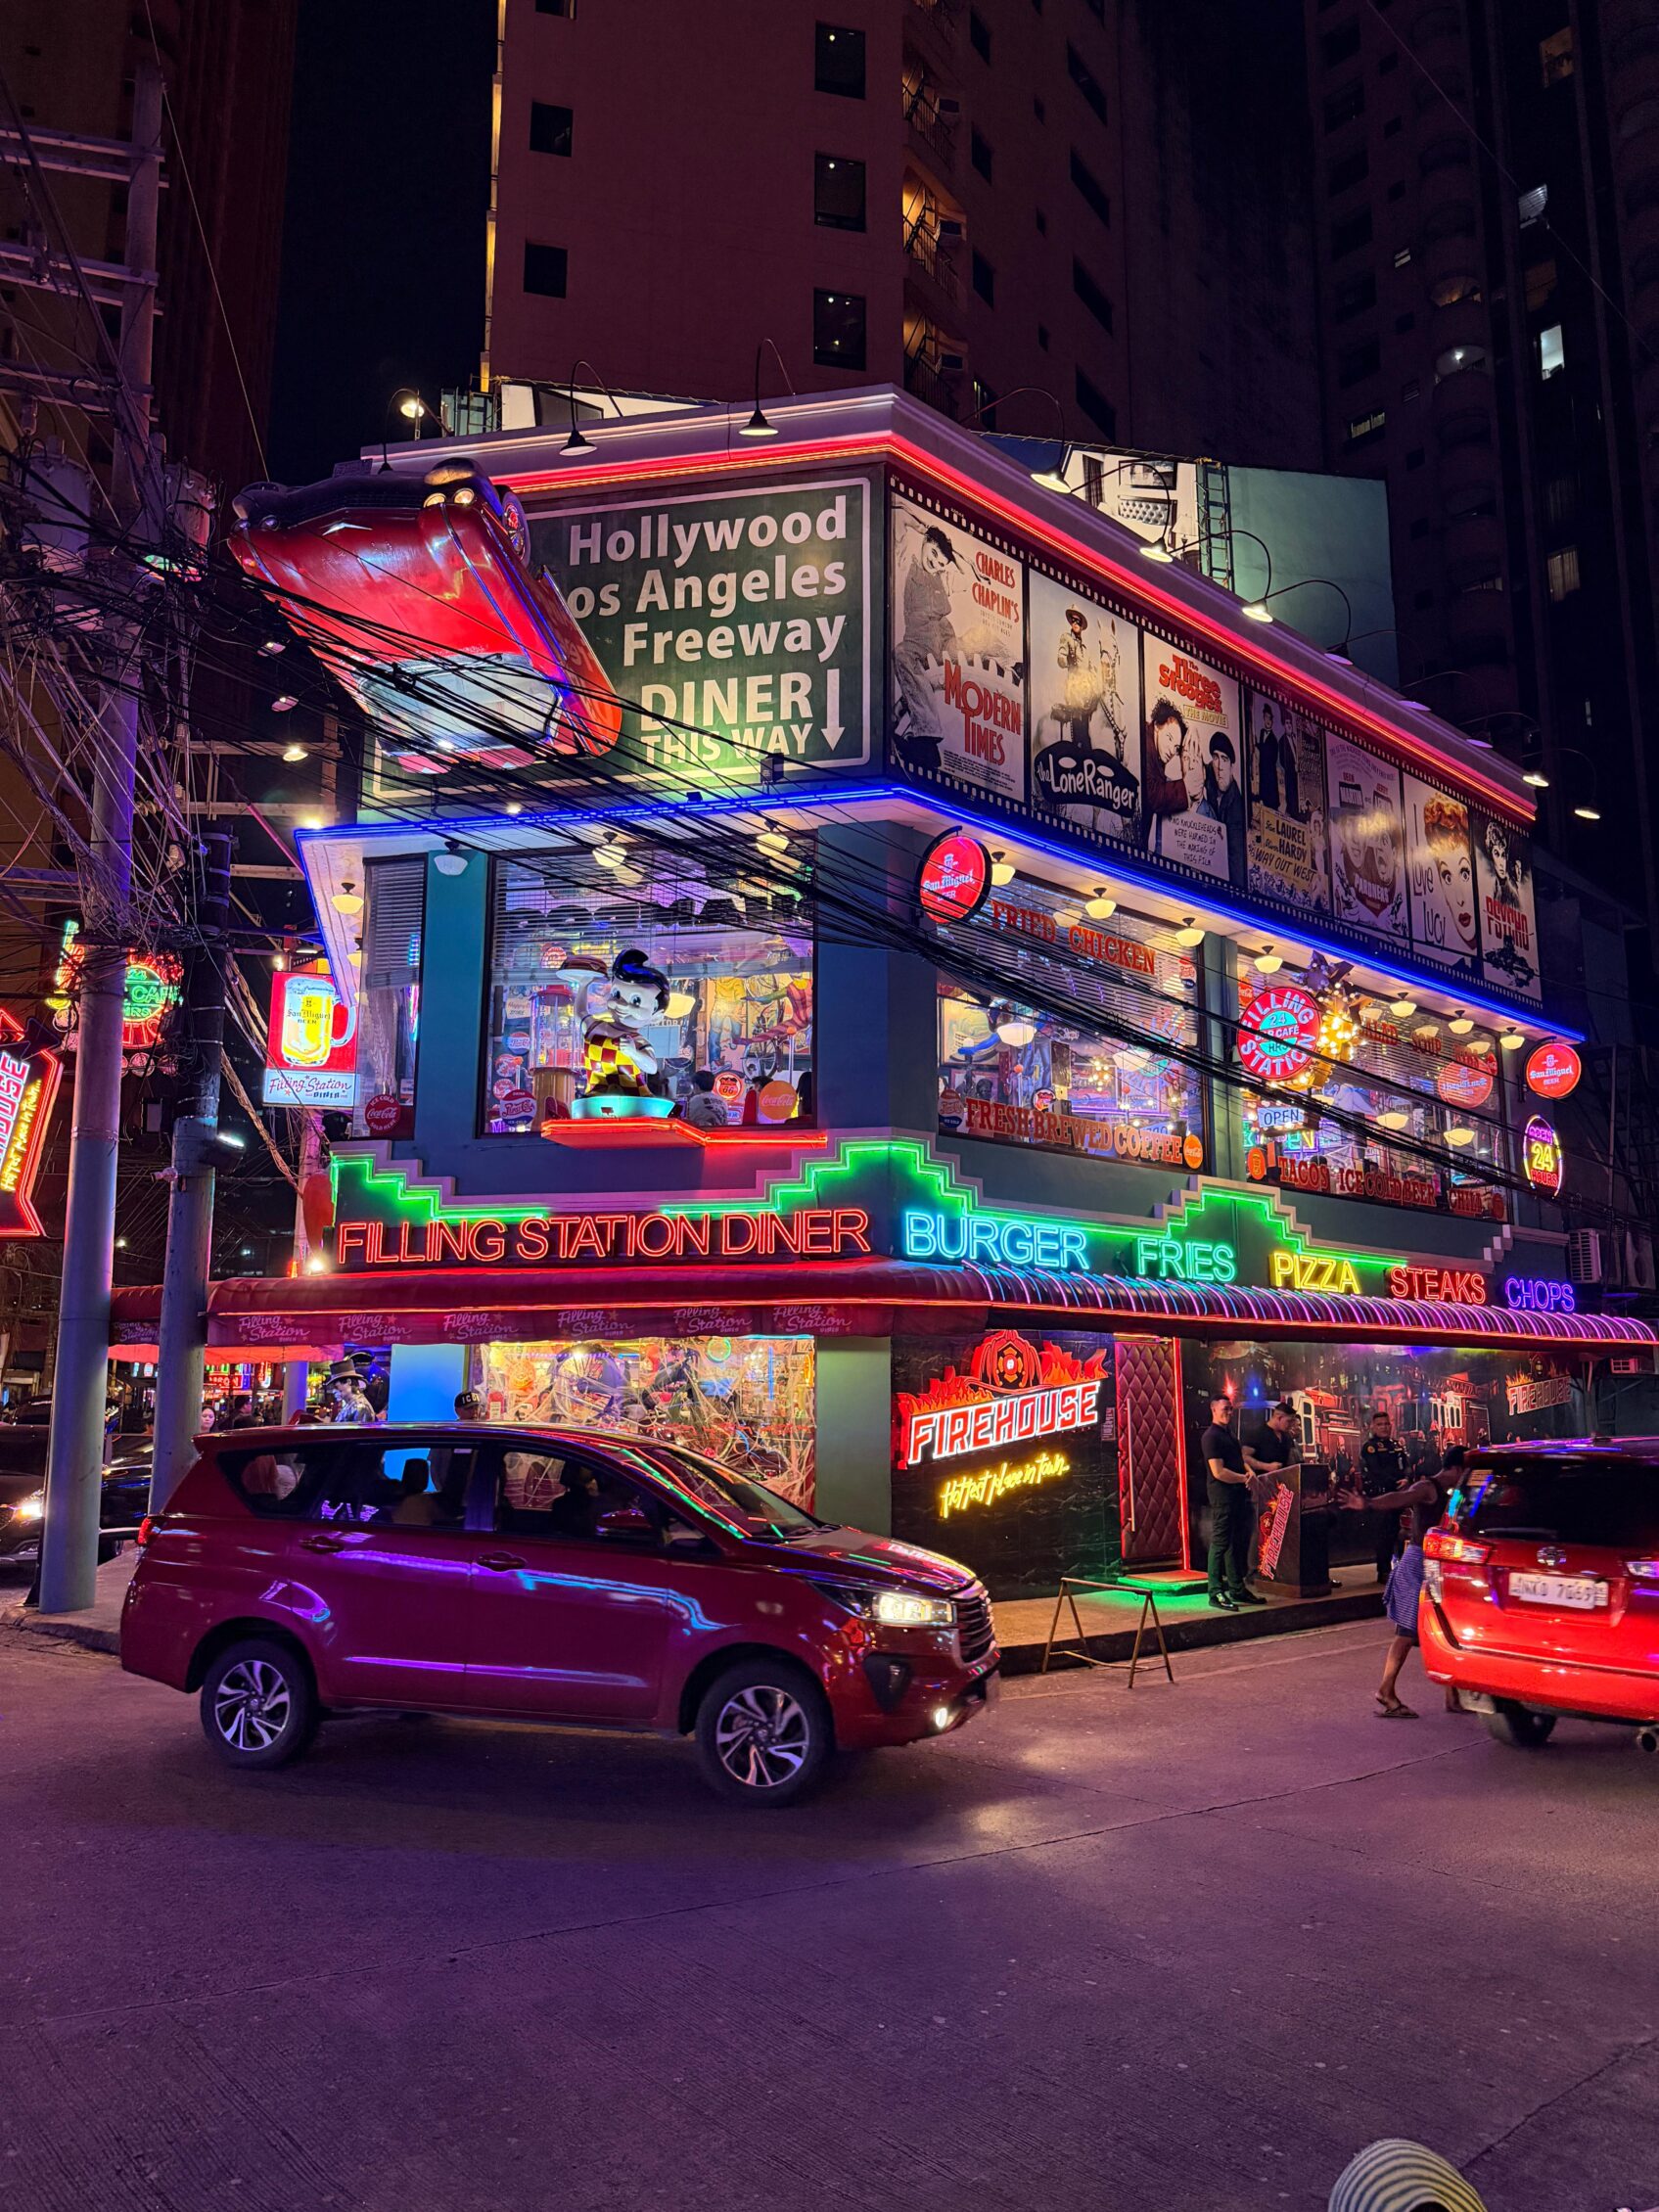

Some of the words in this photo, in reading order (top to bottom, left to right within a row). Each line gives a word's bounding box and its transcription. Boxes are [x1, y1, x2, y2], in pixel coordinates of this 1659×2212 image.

[569, 495, 847, 568] Hollywood
[975, 551, 1016, 589] CHARLES
[567, 583, 621, 619] os
[635, 555, 847, 618] Angeles
[972, 581, 1020, 623] CHAPLIN'S
[623, 615, 847, 667] Freeway
[1158, 664, 1223, 714] Stooges
[1172, 654, 1221, 699] Three
[640, 672, 813, 732] DINER
[945, 659, 1021, 736] MODERN
[1186, 708, 1200, 719] THE
[1202, 712, 1226, 726] MOVIE
[641, 731, 721, 765] THIS
[731, 722, 813, 760] WAY
[961, 707, 1006, 766] TIMES
[1037, 761, 1051, 783] the
[1083, 759, 1135, 810] Ranger
[1181, 819, 1217, 836] KNUCKLEHEADS
[1188, 831, 1209, 844] HARMED
[1275, 819, 1307, 846] LAUREL
[1176, 840, 1186, 850] THE
[1187, 844, 1208, 854] MAKING
[1183, 853, 1197, 864] THIS
[1198, 854, 1212, 866] FILM
[1278, 839, 1307, 862] HARDY
[1255, 848, 1274, 866] WAY
[1275, 857, 1293, 873] OUT
[1293, 863, 1317, 882] WEST
[923, 878, 940, 893] San
[941, 869, 976, 889] Miguel
[990, 899, 1056, 943] FRIED
[1068, 925, 1158, 975] CHICKEN
[1485, 896, 1530, 951] PSYCHO
[287, 1010, 300, 1019] San
[301, 1009, 331, 1019] Miguel
[1270, 1014, 1287, 1026] 24
[1275, 1024, 1300, 1037] CAFÉ
[269, 1078, 305, 1094] Filling
[305, 1077, 352, 1092] Station
[1530, 1069, 1544, 1080] San
[1544, 1064, 1574, 1078] Miguel
[369, 1096, 380, 1107] ICE
[380, 1095, 395, 1104] COLD
[965, 1096, 1031, 1136] FRESH
[1033, 1109, 1113, 1151] BREWED
[1114, 1125, 1183, 1164] COFFEE
[1264, 1109, 1300, 1126] OPEN
[1529, 1126, 1554, 1146] OPEN
[1531, 1142, 1554, 1172] 24
[1278, 1156, 1330, 1191] TACOS
[1338, 1167, 1364, 1195] ICE
[1364, 1173, 1403, 1200] COLD
[1403, 1180, 1437, 1206] BEER
[1530, 1169, 1559, 1187] HOURS
[339, 1219, 507, 1265] FILLING
[516, 1213, 711, 1261] STATION
[720, 1208, 871, 1257] DINER
[904, 1211, 1090, 1271] BURGER
[1136, 1236, 1237, 1283] FRIES
[1272, 1251, 1362, 1295] PIZZA
[1389, 1266, 1488, 1306] STEAKS
[1505, 1276, 1576, 1313] CHOPS
[239, 1314, 283, 1333] Filling
[339, 1313, 386, 1333] Filling
[443, 1312, 490, 1332] Filling
[557, 1310, 606, 1328] Filling
[673, 1306, 723, 1324] Filling
[687, 1317, 753, 1333] Station
[773, 1305, 824, 1322] Filling
[785, 1315, 853, 1333] Station
[250, 1324, 310, 1343] Station
[350, 1324, 412, 1342] Station
[456, 1323, 519, 1340] Station
[571, 1321, 635, 1337] Station
[1508, 1375, 1572, 1416] FIREHOUSE
[907, 1381, 1102, 1465] FIREHOUSE
[940, 1470, 992, 1519] Hottest
[1264, 1487, 1294, 1581] FIREHOUSE
